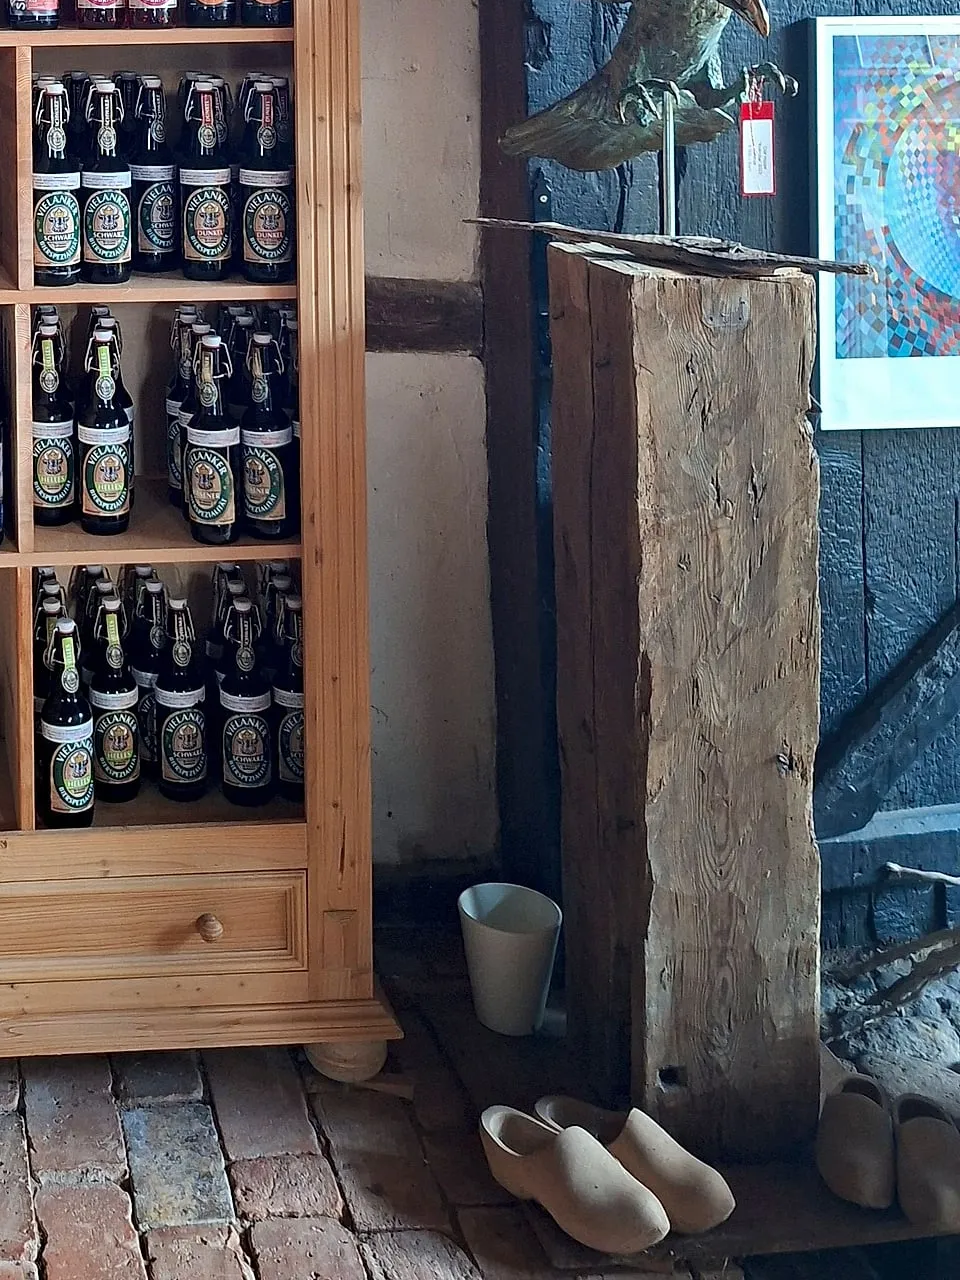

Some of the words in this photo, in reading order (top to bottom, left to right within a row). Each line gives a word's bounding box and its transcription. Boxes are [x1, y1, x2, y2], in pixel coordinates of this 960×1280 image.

[37, 194, 78, 216] VIELANKER
[87, 192, 129, 214] VIELANKER
[188, 189, 229, 212] VIELANKER
[248, 191, 289, 214] VIELANKER
[44, 232, 75, 242] SCHWARZ
[93, 231, 125, 239] SCHWARZ
[196, 229, 223, 237] DUNKEL
[256, 231, 283, 239] DUNKEL
[32, 438, 72, 459] VIELANKER
[97, 713, 137, 733] VIELANKER
[225, 717, 268, 738] VIELANKER
